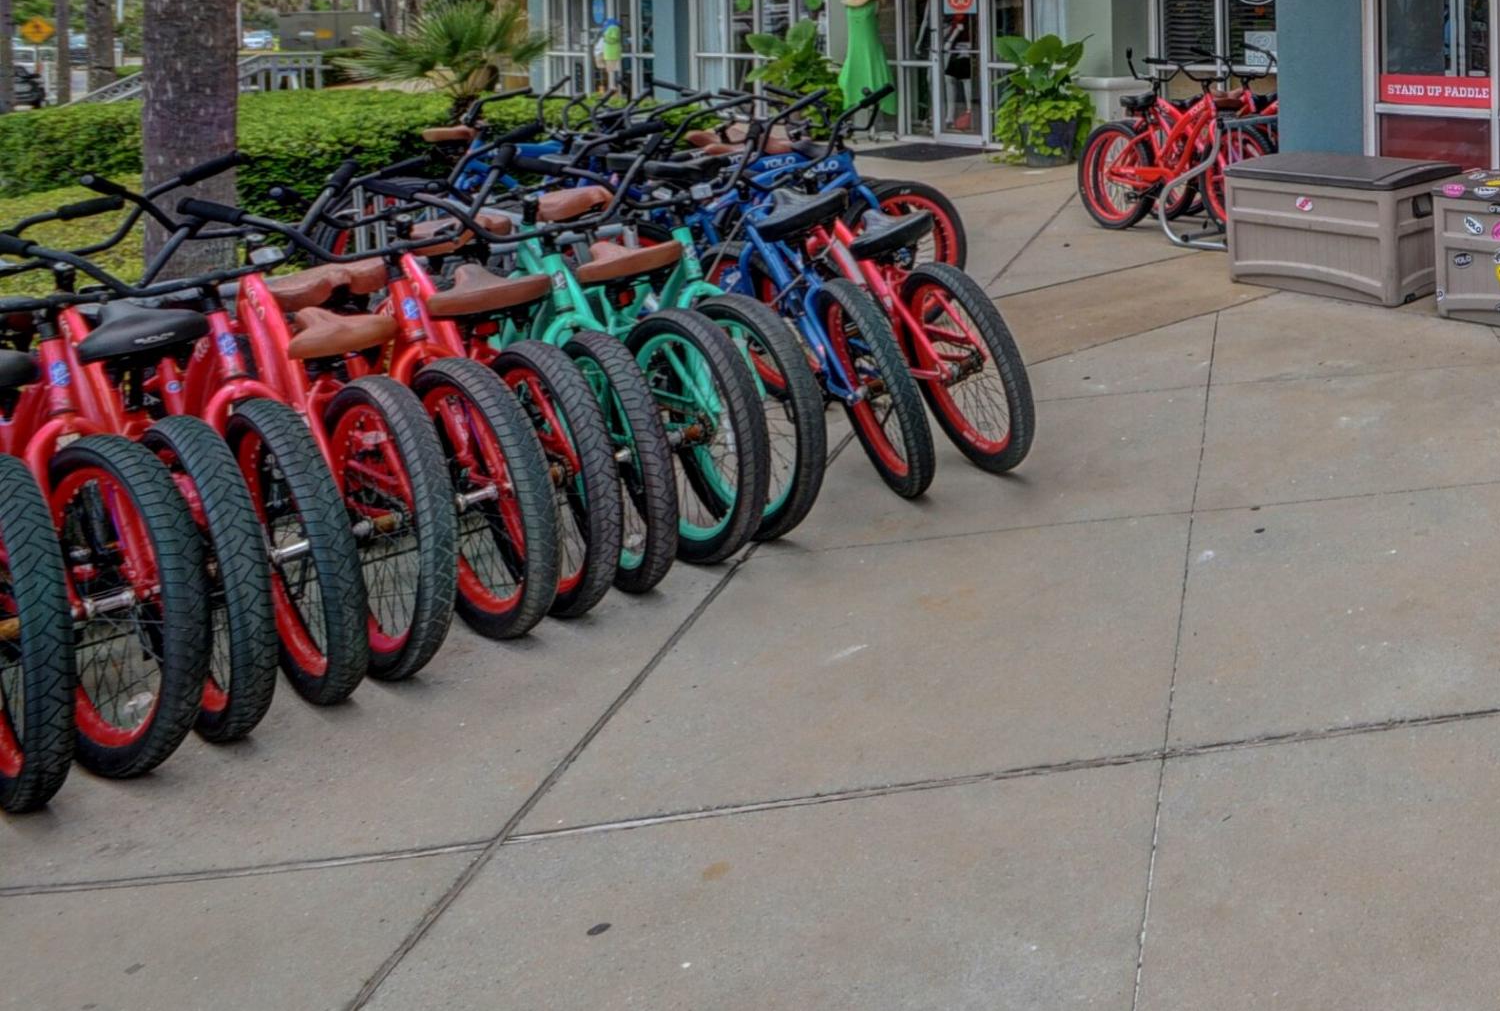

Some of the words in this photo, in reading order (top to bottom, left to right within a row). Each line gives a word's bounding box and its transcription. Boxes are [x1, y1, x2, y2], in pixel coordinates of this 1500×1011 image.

[1387, 84, 1424, 96] STAND
[1427, 85, 1442, 97] UP
[1444, 86, 1490, 99] PADDLE
[763, 156, 796, 169] YOLO
[1465, 217, 1482, 233] YOLO
[1454, 255, 1472, 264] YOLO
